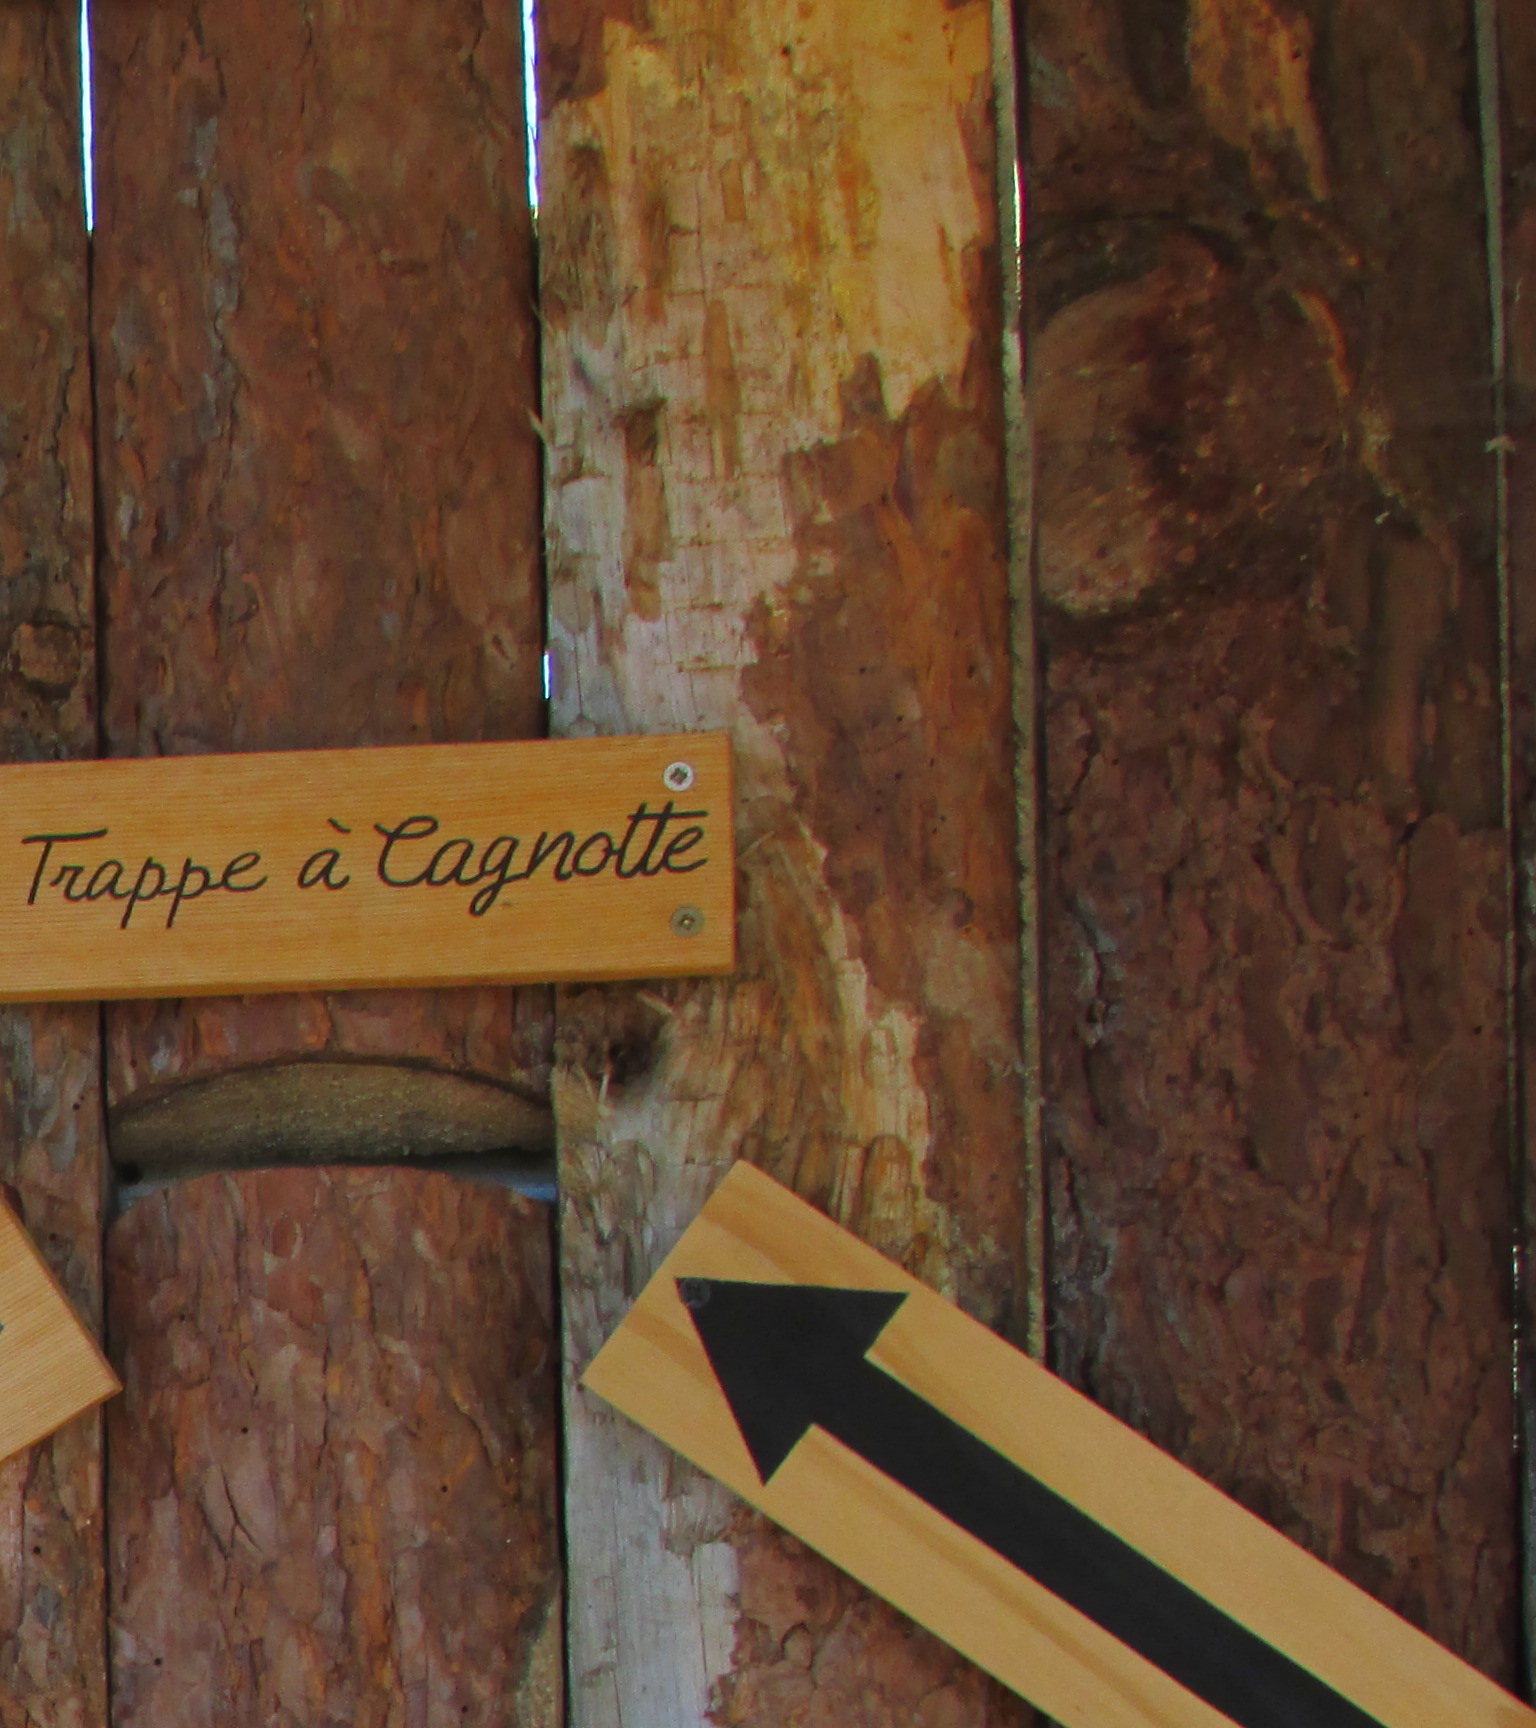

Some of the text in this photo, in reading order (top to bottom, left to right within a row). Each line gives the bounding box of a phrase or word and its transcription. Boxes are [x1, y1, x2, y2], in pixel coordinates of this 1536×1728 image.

[20, 827, 269, 931] Trappe
[296, 816, 352, 893] à
[374, 801, 711, 918] Cagnotte
